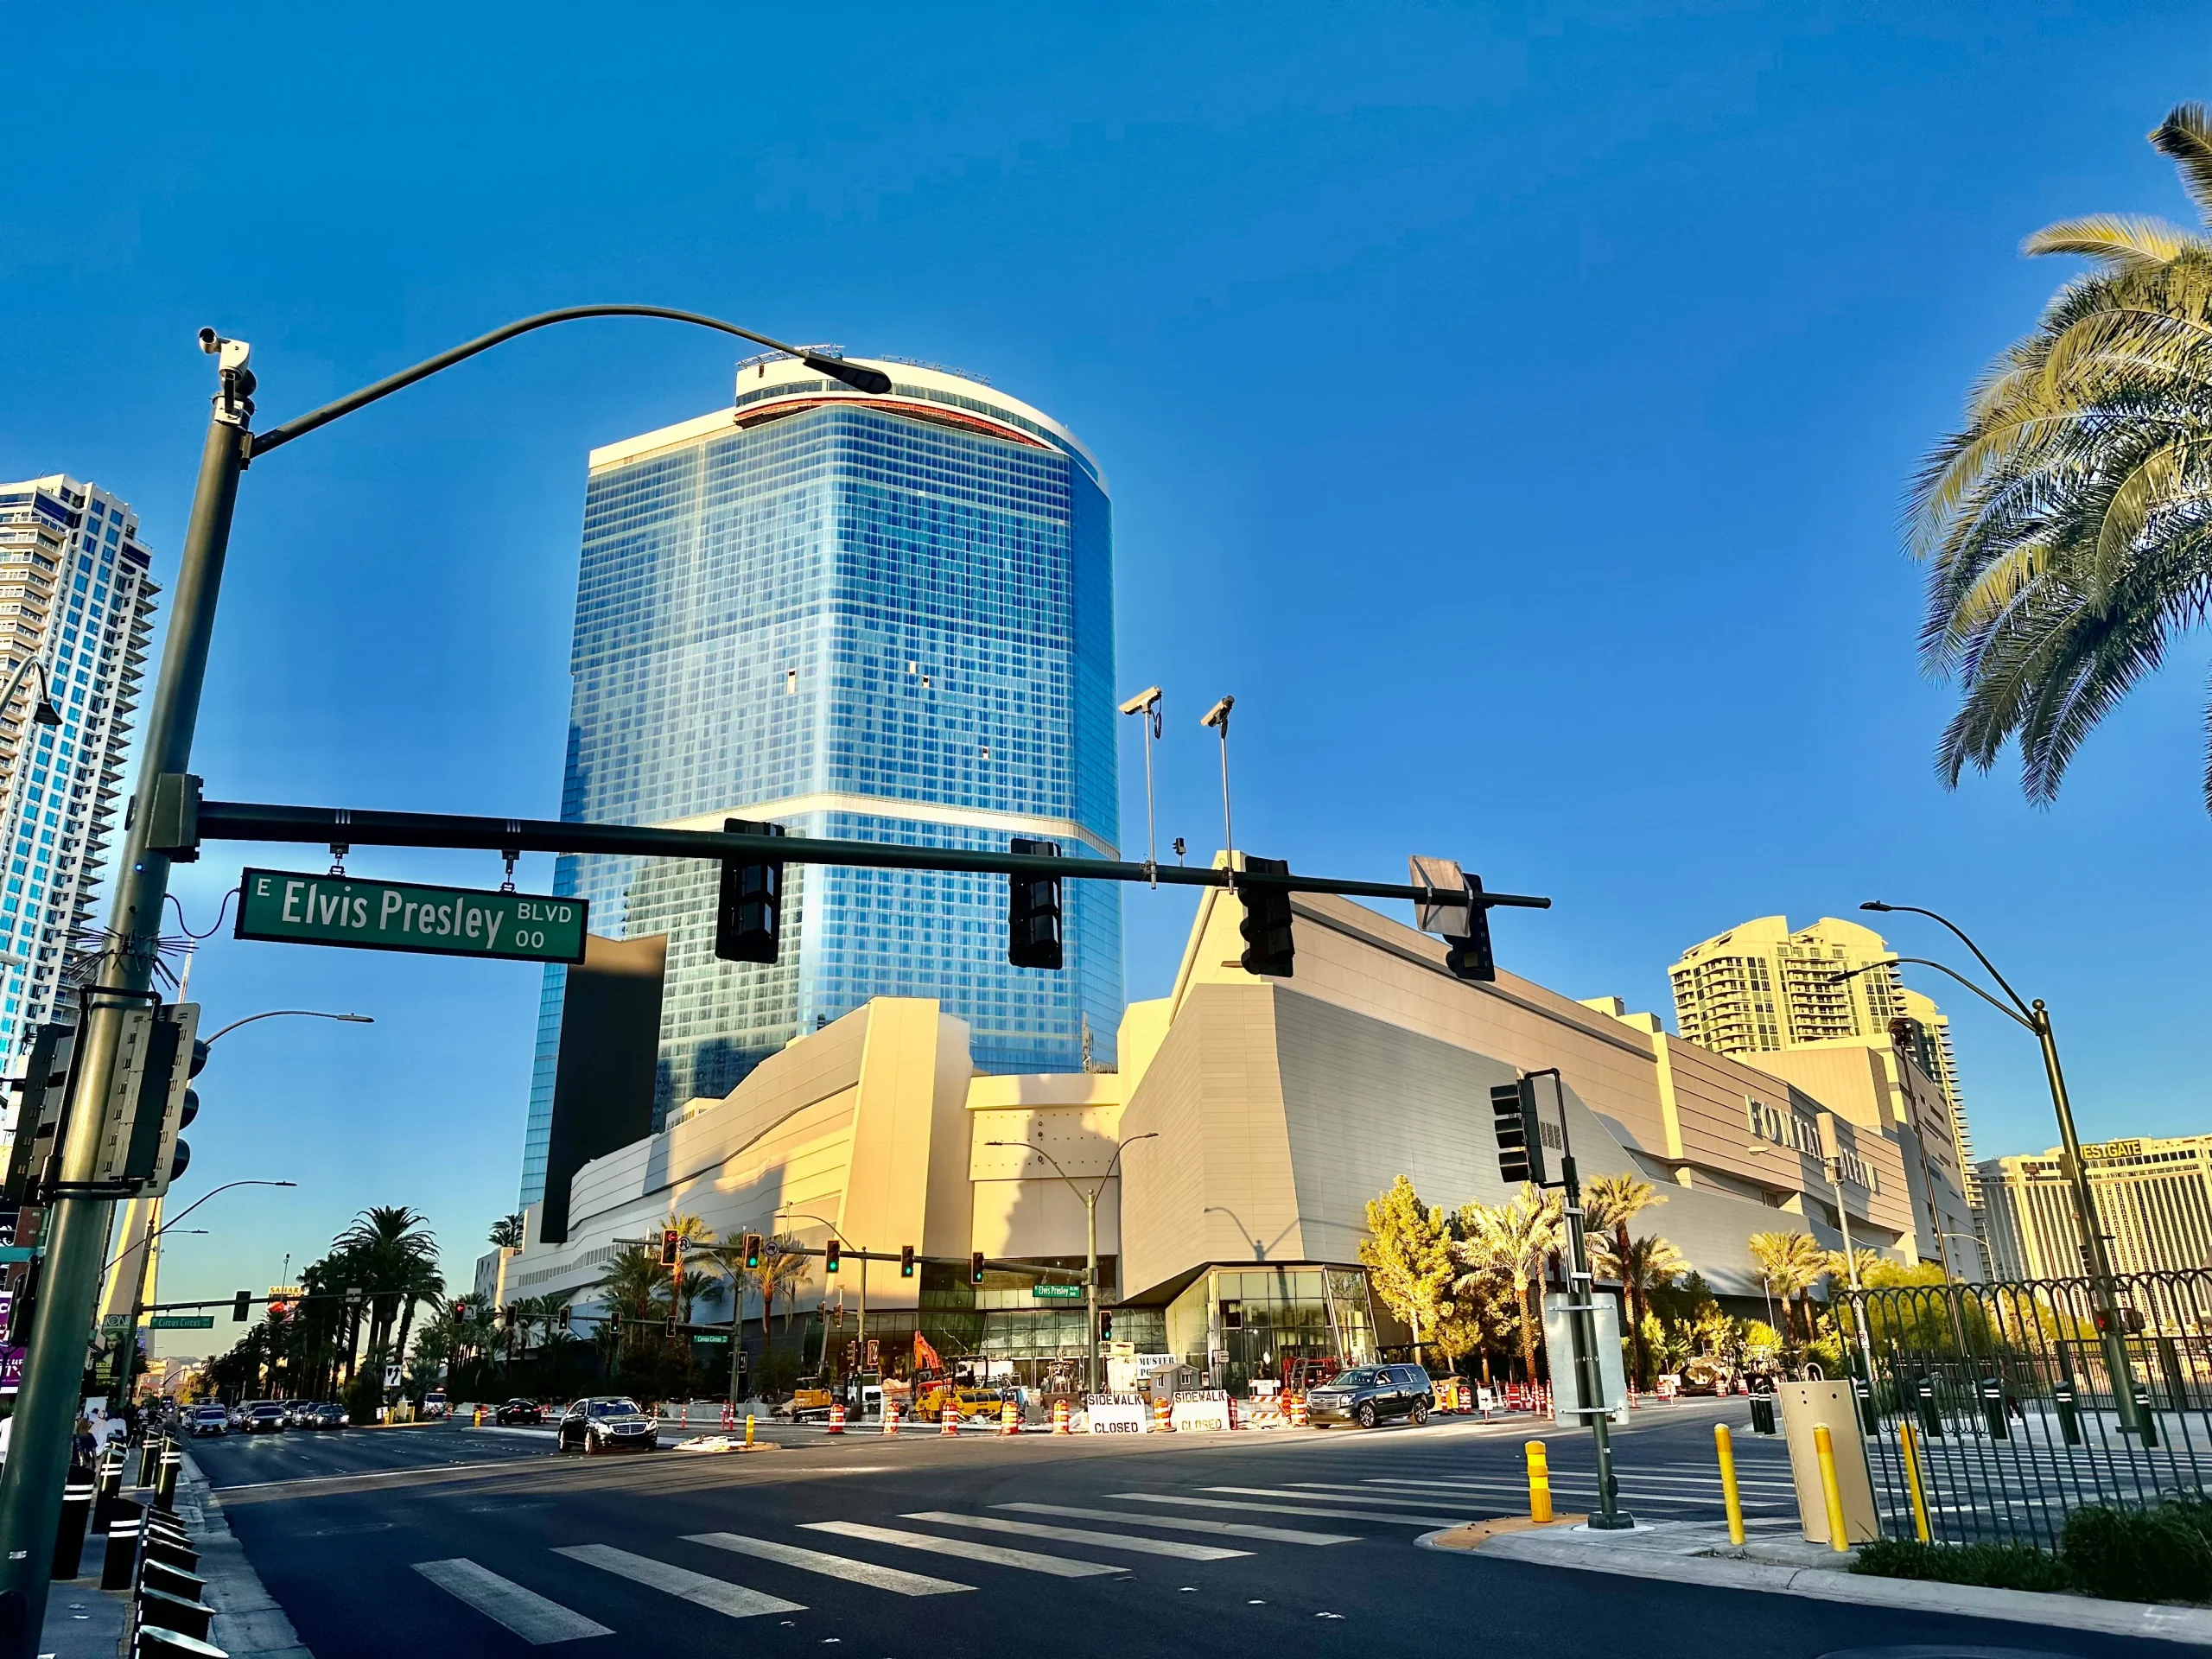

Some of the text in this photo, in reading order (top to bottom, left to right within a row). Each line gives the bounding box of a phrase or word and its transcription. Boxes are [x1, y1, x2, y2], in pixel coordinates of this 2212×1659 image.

[257, 878, 572, 950] E Elvis Presley BLVD
[515, 930, 545, 949] 00
[1744, 1093, 1877, 1192] FONTAIBLEAU
[2080, 1141, 2141, 1160] ESTGATE
[1039, 1285, 1051, 1294] Elvis
[1051, 1285, 1069, 1297] Presley
[158, 1318, 180, 1327] Circus
[180, 1318, 200, 1327] Circus
[1139, 1356, 1175, 1366] MUSTER
[1088, 1394, 1141, 1406] SIDEWALK
[1175, 1390, 1225, 1403] SIDEWALK
[1094, 1421, 1139, 1433] CLOSED
[1180, 1418, 1223, 1431] CLOSED
